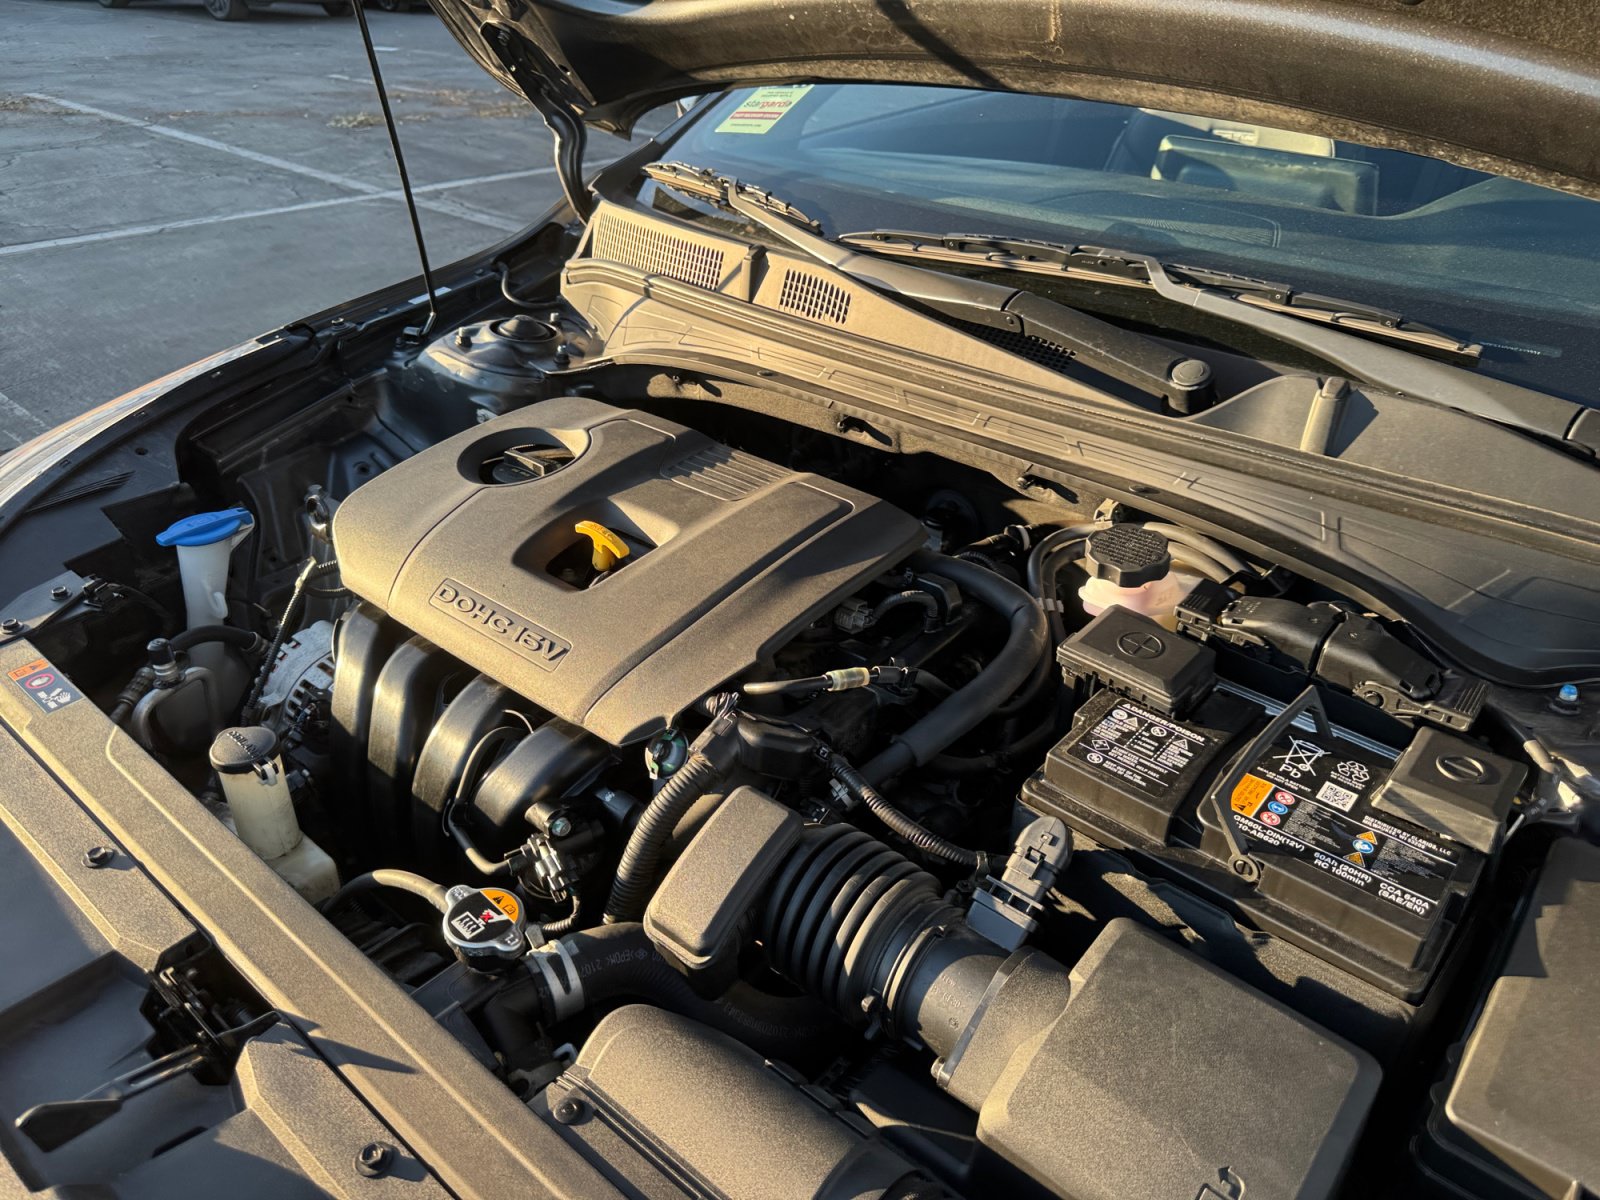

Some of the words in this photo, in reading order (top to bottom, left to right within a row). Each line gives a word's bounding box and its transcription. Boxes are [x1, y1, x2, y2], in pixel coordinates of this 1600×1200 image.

[434, 583, 515, 634] DOHC
[1130, 706, 1204, 741] DANGER/POISON
[1279, 763, 1300, 777] Pb
[1233, 815, 1304, 850] GM60L-DIN(12V)
[1439, 847, 1451, 855] LLC
[1314, 852, 1337, 866] 60Ah
[1339, 864, 1371, 882] (20HR)
[1314, 859, 1328, 868] RC
[1332, 866, 1364, 885] 100min
[1378, 889, 1424, 914] (SAE/EN)
[1379, 882, 1401, 896] CCA
